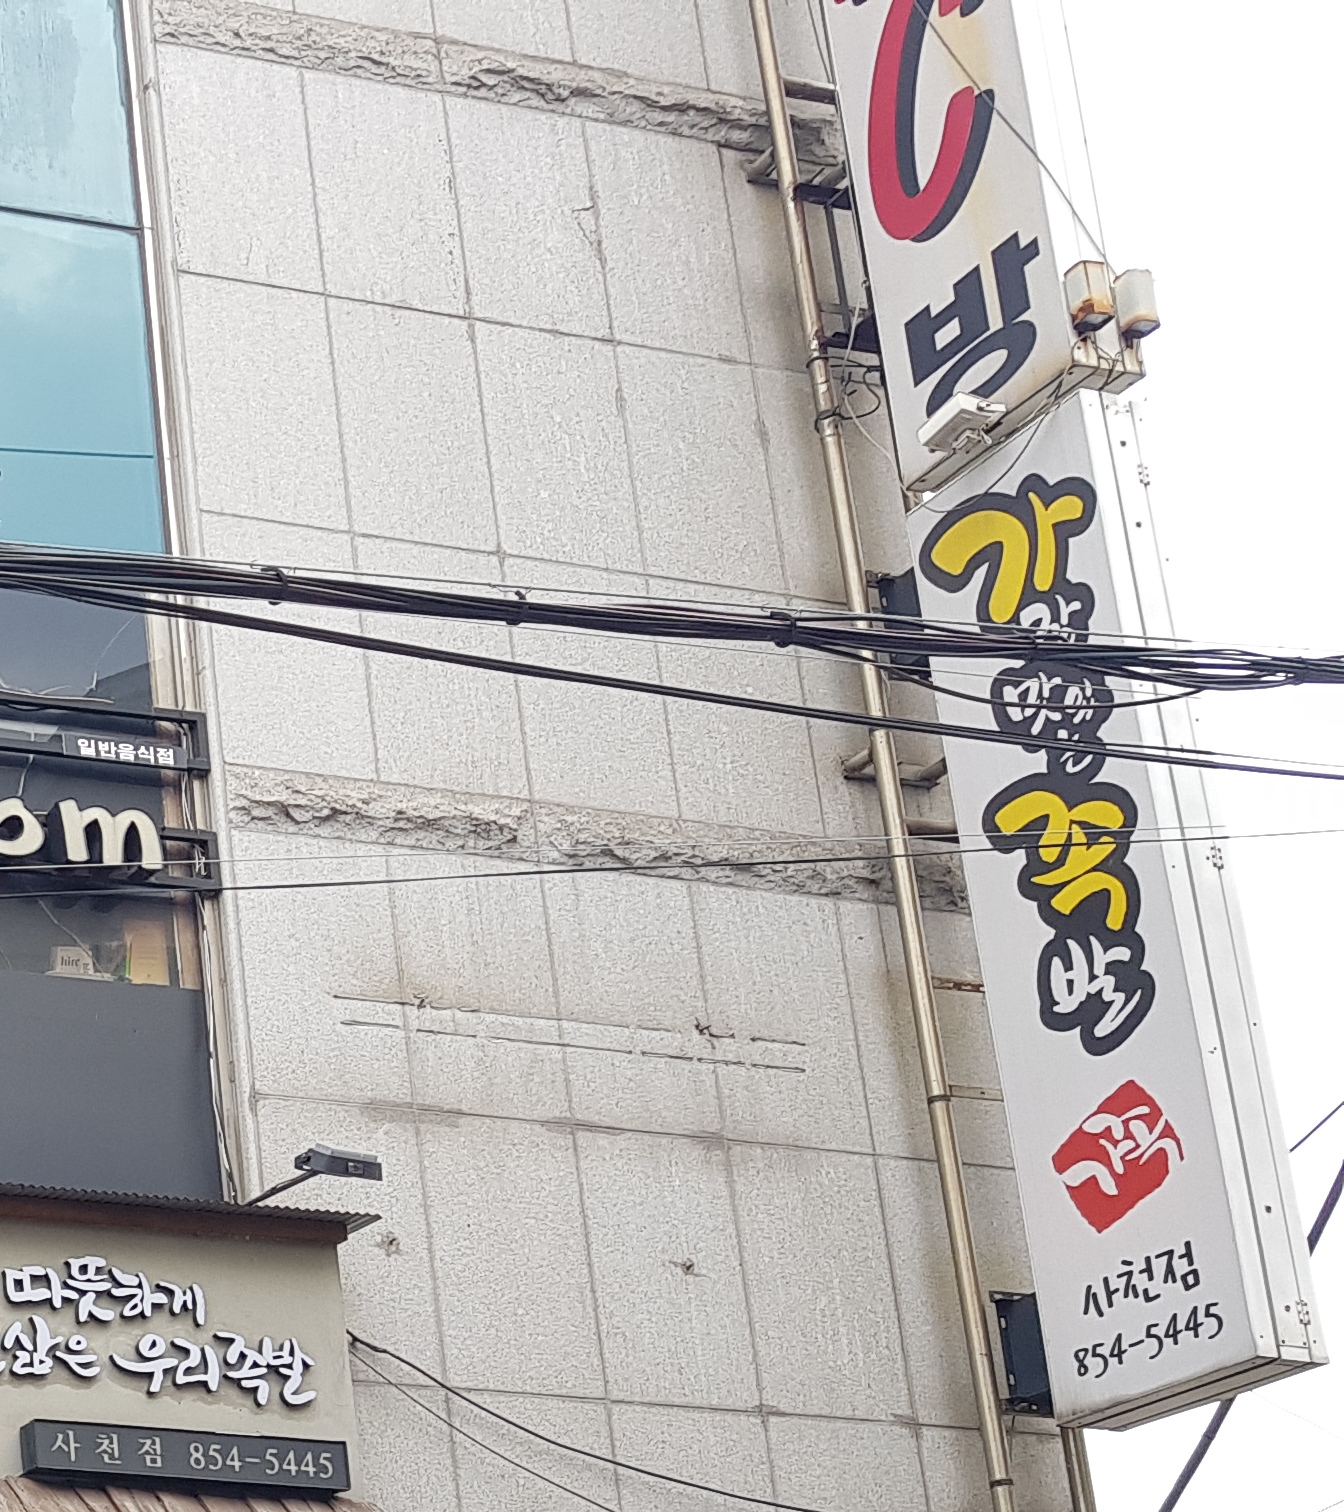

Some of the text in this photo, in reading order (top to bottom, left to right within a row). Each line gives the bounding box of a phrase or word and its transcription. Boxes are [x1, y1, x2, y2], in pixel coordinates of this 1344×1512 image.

[903, 231, 1038, 418] 방
[77, 738, 175, 766] 일반음식점
[993, 789, 1144, 1040] 족발
[4, 1256, 206, 1326] 따뜻하게
[1082, 1241, 1201, 1319] 사천점
[1073, 1302, 1226, 1378] 854-5445
[188, 1442, 334, 1480] 854-5445
